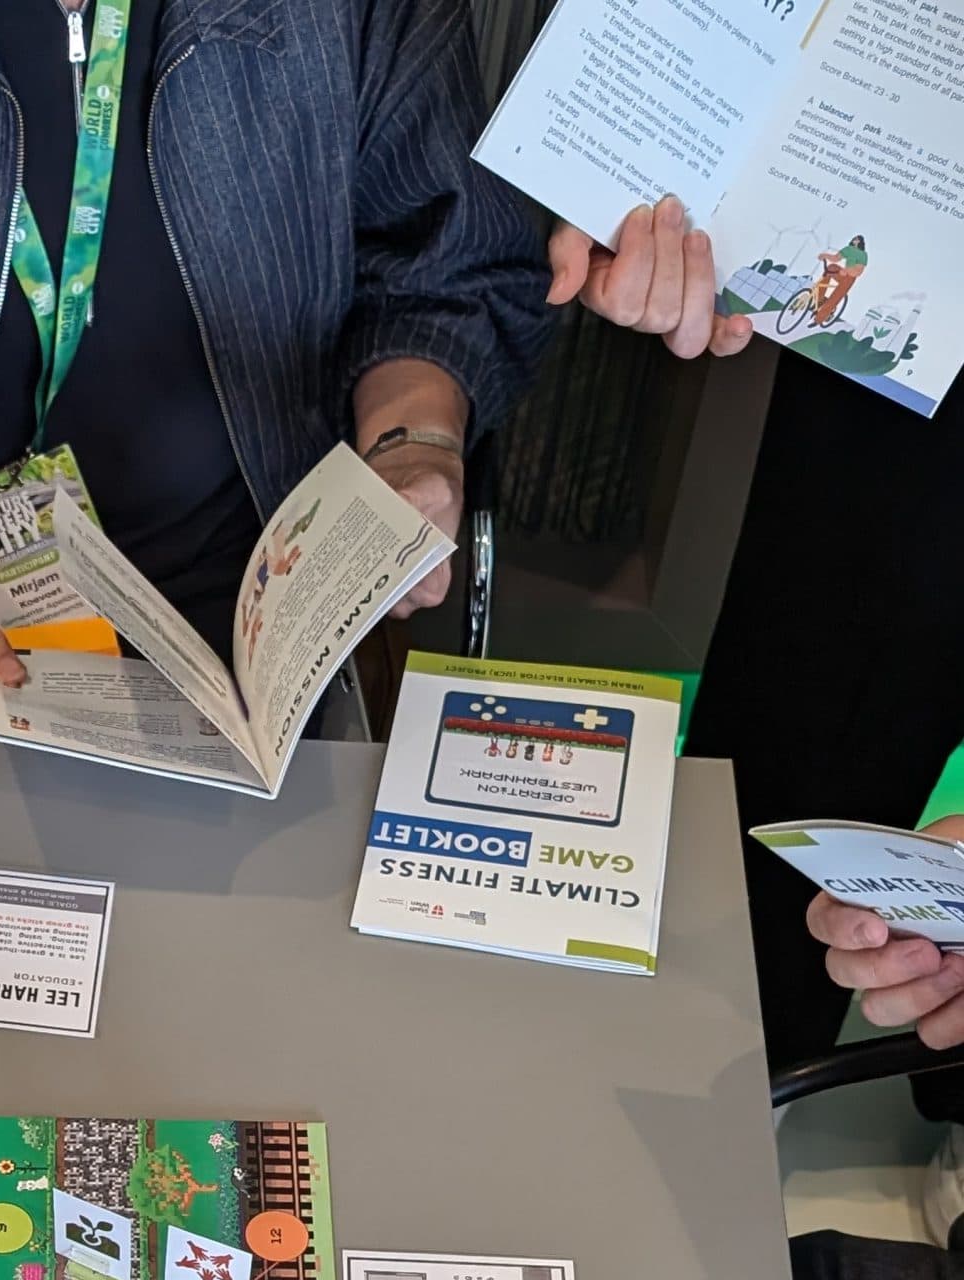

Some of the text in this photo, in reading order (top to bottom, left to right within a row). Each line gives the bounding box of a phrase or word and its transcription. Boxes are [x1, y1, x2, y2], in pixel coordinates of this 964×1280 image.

[819, 60, 900, 104] Score Bracket: 23 30
[84, 99, 102, 149] WORLD
[818, 101, 882, 137] balanced park
[767, 166, 848, 209] Score Bracket: 16 22
[8, 570, 61, 600] Mirjam
[335, 574, 389, 641] GAME
[443, 662, 486, 676] PROJECT
[519, 670, 563, 683] REACTOR
[566, 675, 608, 687] CLIMATE
[610, 680, 644, 691] URBAN
[276, 646, 330, 756] MISSION
[459, 766, 597, 794] WESTBAHNPARK
[373, 820, 634, 874] GAME BOOKLET
[378, 856, 640, 909] CLIMATE FITNESS
[824, 878, 928, 894] CLIMATE
[874, 905, 951, 921] GAME
[12, 972, 76, 985] EDUCATOR
[44, 989, 80, 1007] LEE
[270, 1228, 282, 1243] 12
